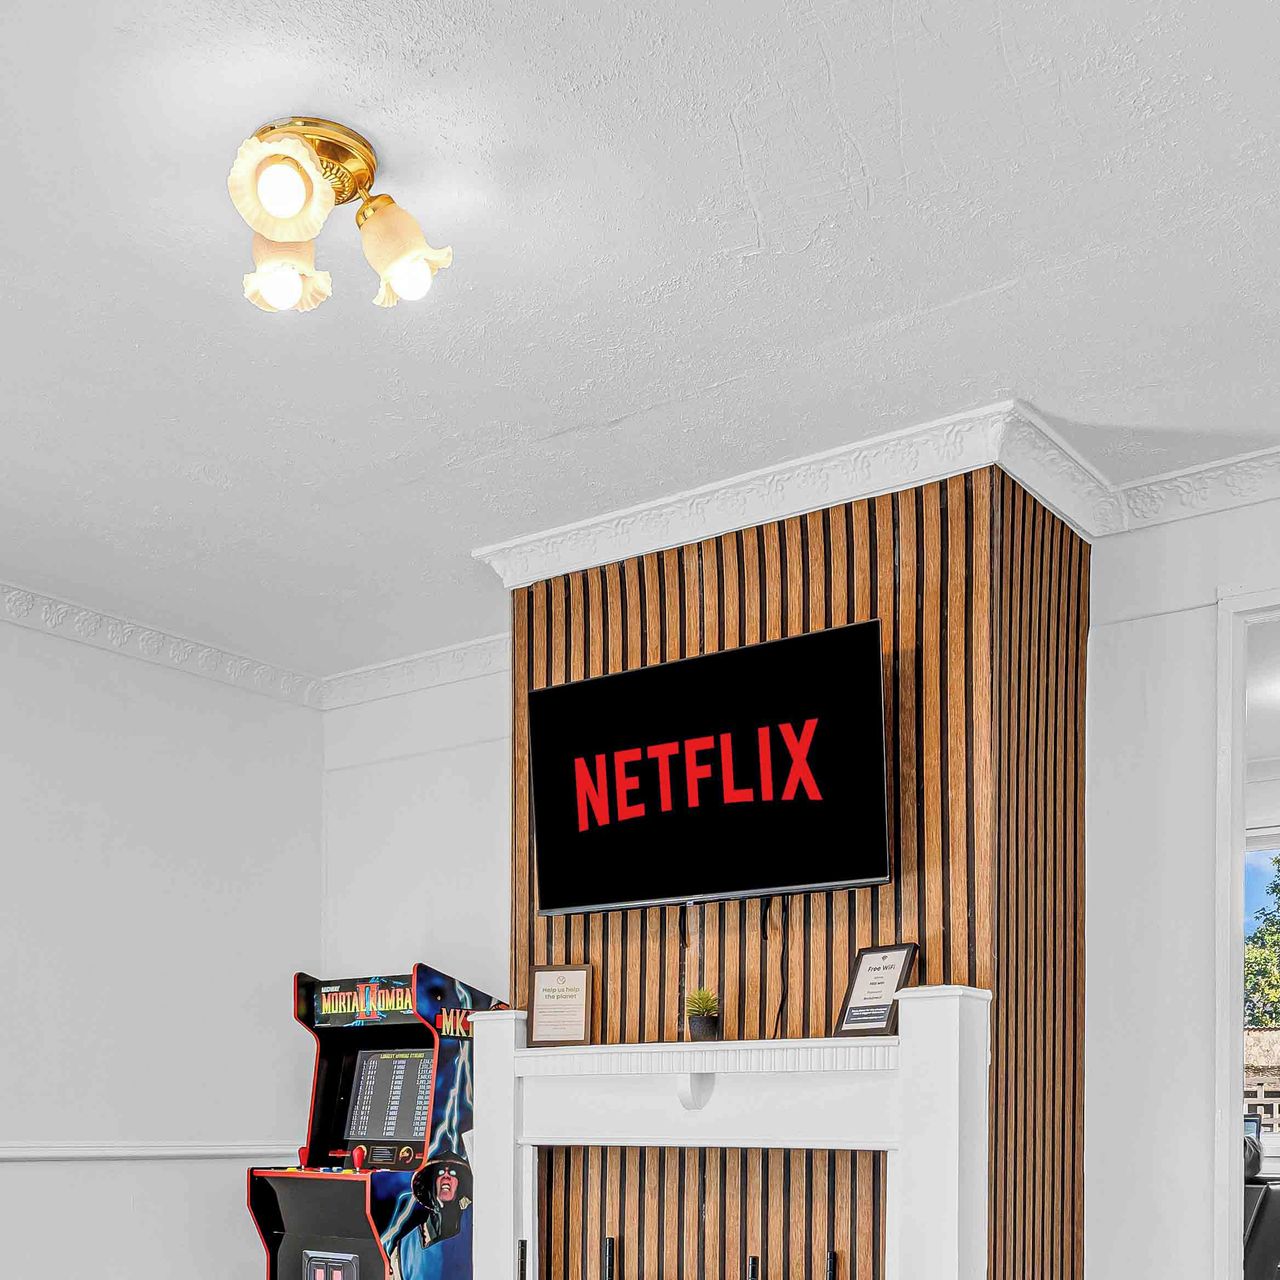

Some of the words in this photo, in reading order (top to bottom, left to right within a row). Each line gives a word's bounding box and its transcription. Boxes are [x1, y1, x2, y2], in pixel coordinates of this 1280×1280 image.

[574, 718, 824, 832] NETFLIX
[321, 991, 365, 1014] MORTAL
[368, 987, 413, 1012] KOMBA
